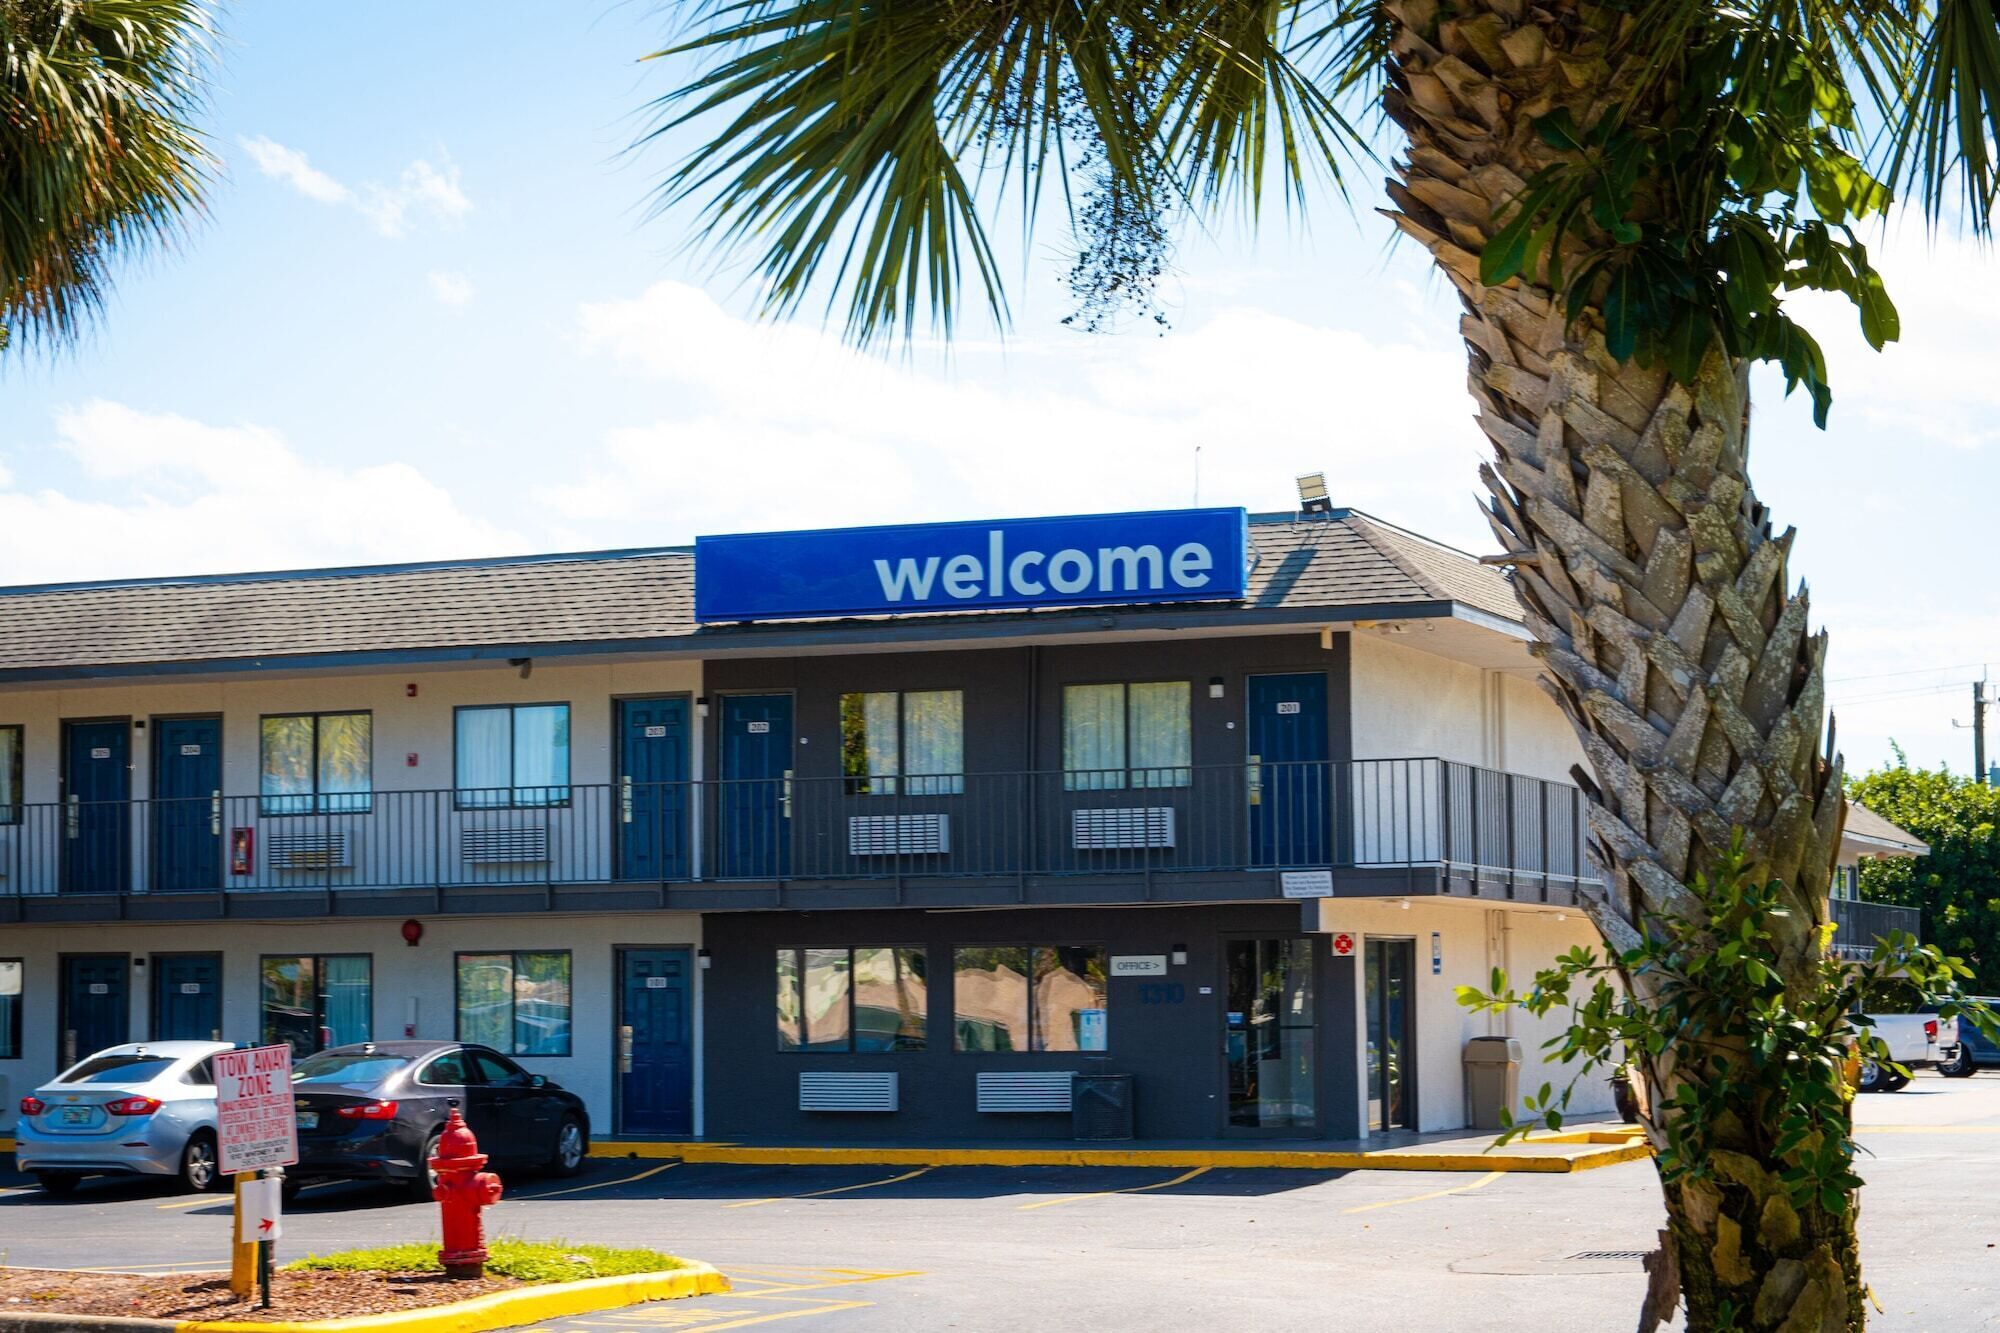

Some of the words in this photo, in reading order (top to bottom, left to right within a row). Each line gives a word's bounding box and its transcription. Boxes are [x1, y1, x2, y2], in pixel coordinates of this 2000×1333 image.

[874, 530, 1213, 602] welcome
[1281, 703, 1297, 712] 201
[1117, 961, 1152, 970] OFFICE
[218, 1054, 247, 1077] TOW
[254, 1049, 286, 1074] AWAY
[238, 1074, 272, 1097] ZONE
